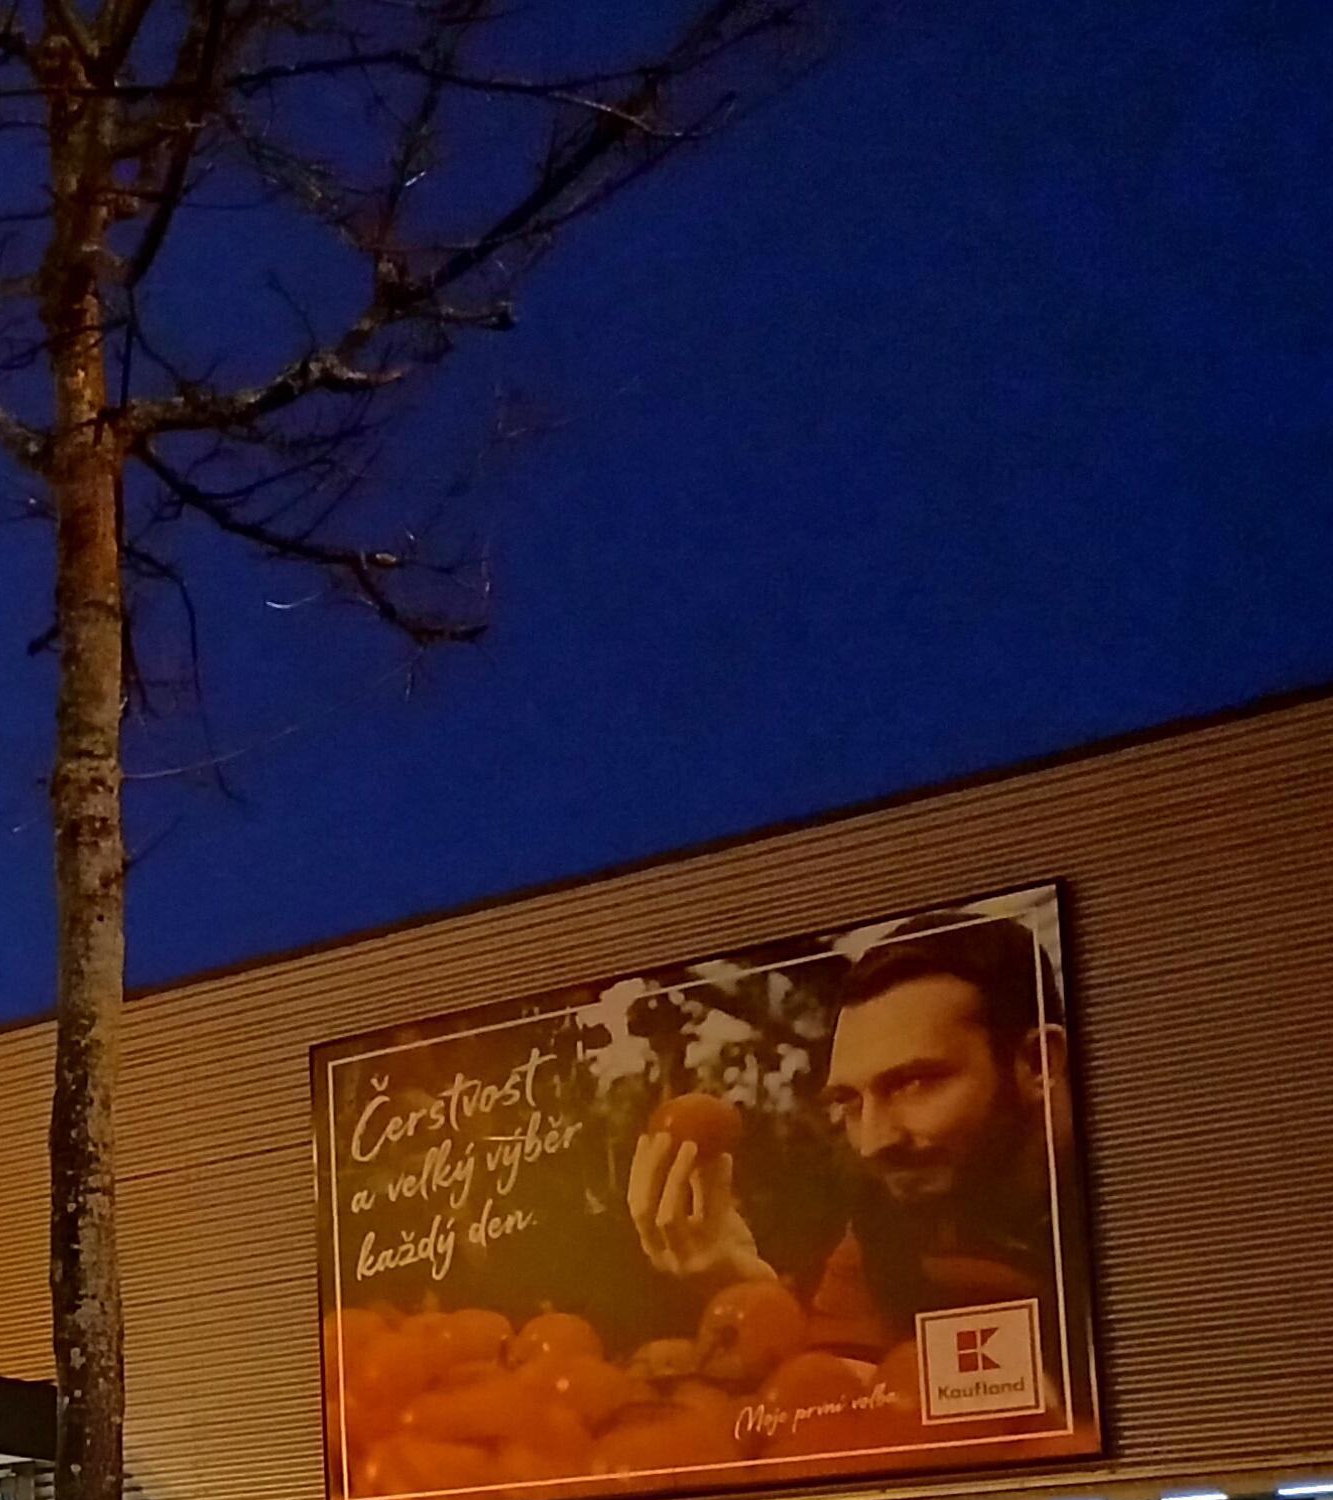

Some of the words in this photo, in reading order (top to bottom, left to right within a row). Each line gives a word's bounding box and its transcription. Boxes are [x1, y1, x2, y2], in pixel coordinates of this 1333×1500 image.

[351, 1047, 557, 1162] Čerstvost
[351, 1189, 376, 1213] a
[388, 1138, 475, 1209] velký
[486, 1111, 583, 1196] výběr
[356, 1214, 455, 1281] každý
[937, 1376, 1025, 1401] Kaufland
